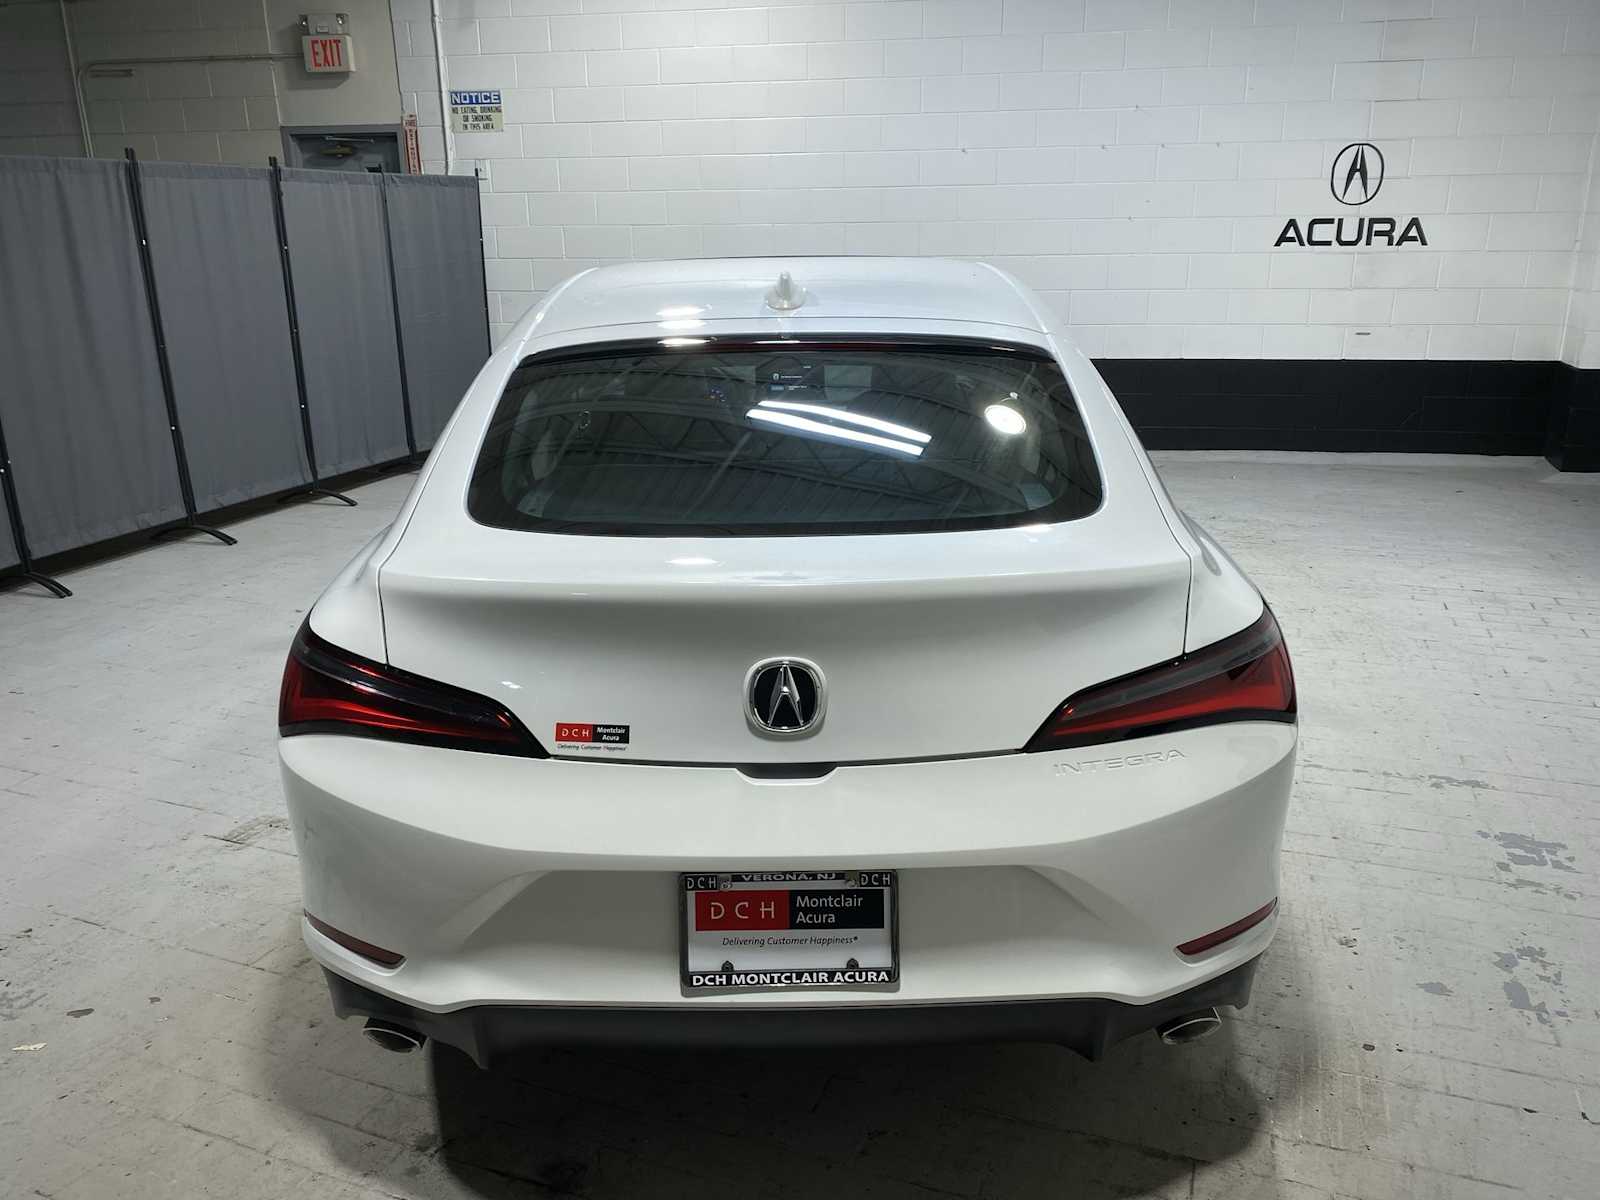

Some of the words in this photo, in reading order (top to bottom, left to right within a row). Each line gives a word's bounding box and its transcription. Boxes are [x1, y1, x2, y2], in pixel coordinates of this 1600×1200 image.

[310, 39, 342, 67] EXIT
[451, 92, 500, 104] NOTICE
[1273, 217, 1428, 247] ACURA
[1053, 750, 1185, 776] INTEGRA
[817, 872, 836, 880] NJ
[796, 895, 863, 908] Montclair
[796, 911, 836, 924] Acura
[722, 937, 765, 948] Delivering
[767, 937, 807, 945] Customer
[692, 975, 727, 986] DCH
[731, 973, 829, 985] MONTCLAIR
[833, 971, 890, 983] ACURA
